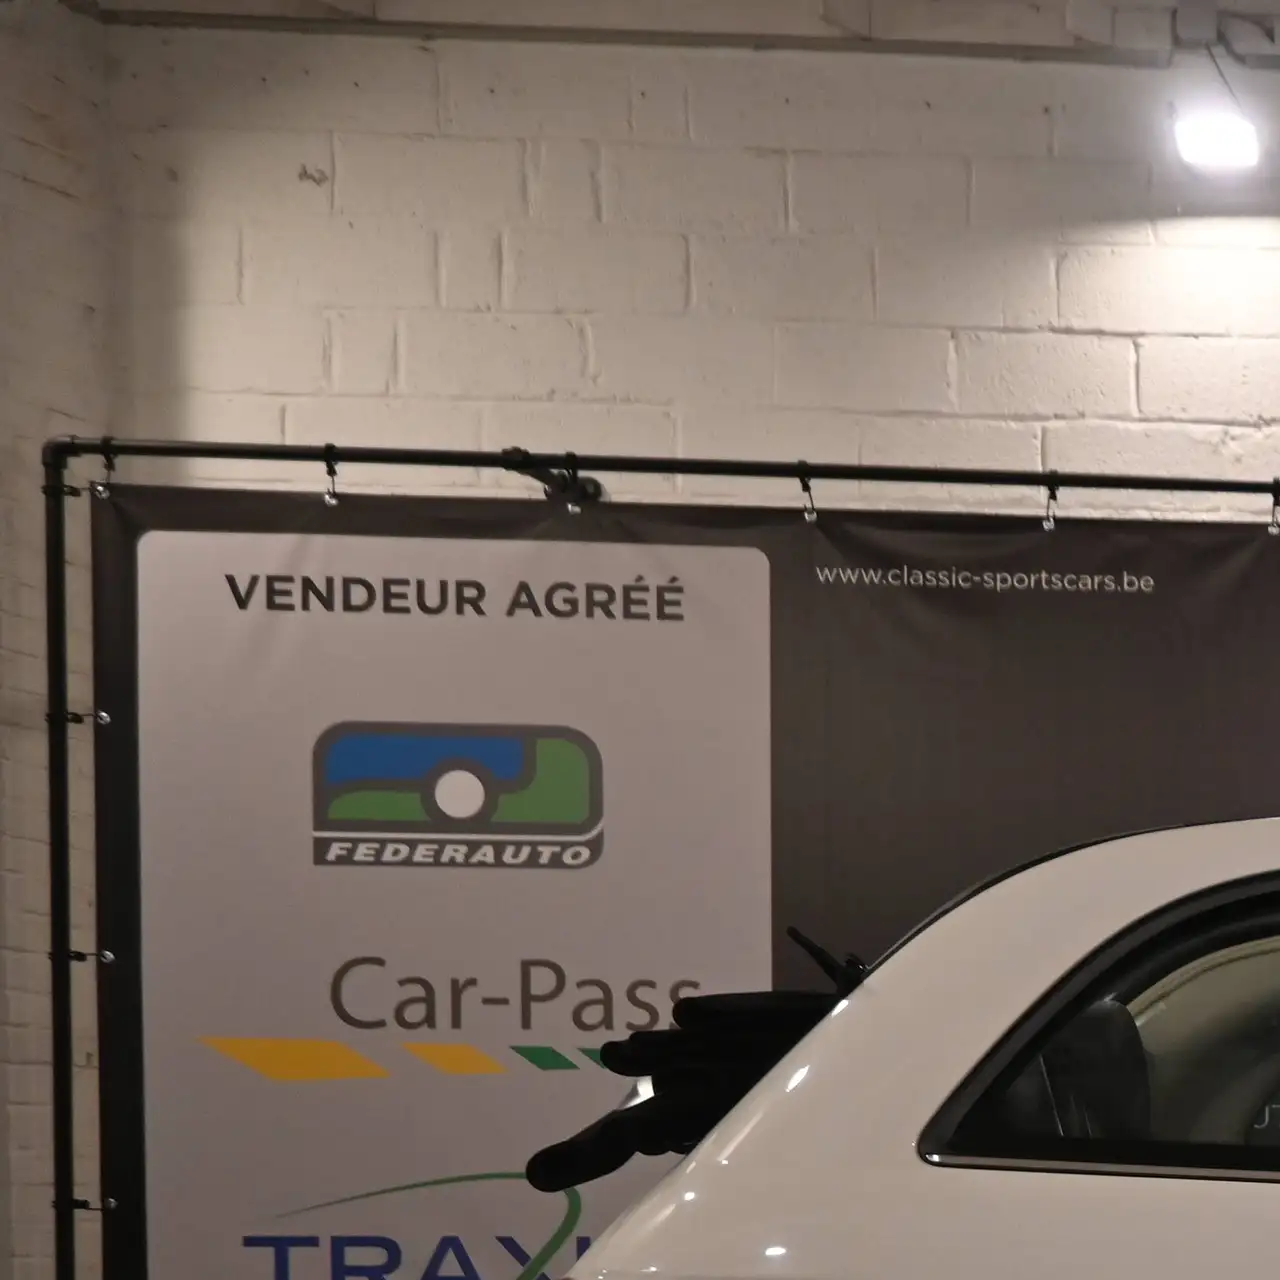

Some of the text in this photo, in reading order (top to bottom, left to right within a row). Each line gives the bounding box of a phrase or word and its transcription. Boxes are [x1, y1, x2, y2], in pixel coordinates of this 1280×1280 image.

[815, 564, 1156, 594] www.classic-sportscars.be
[224, 573, 686, 622] VENDEUR AGRÉÉ
[324, 841, 592, 866] FEDERAUTO
